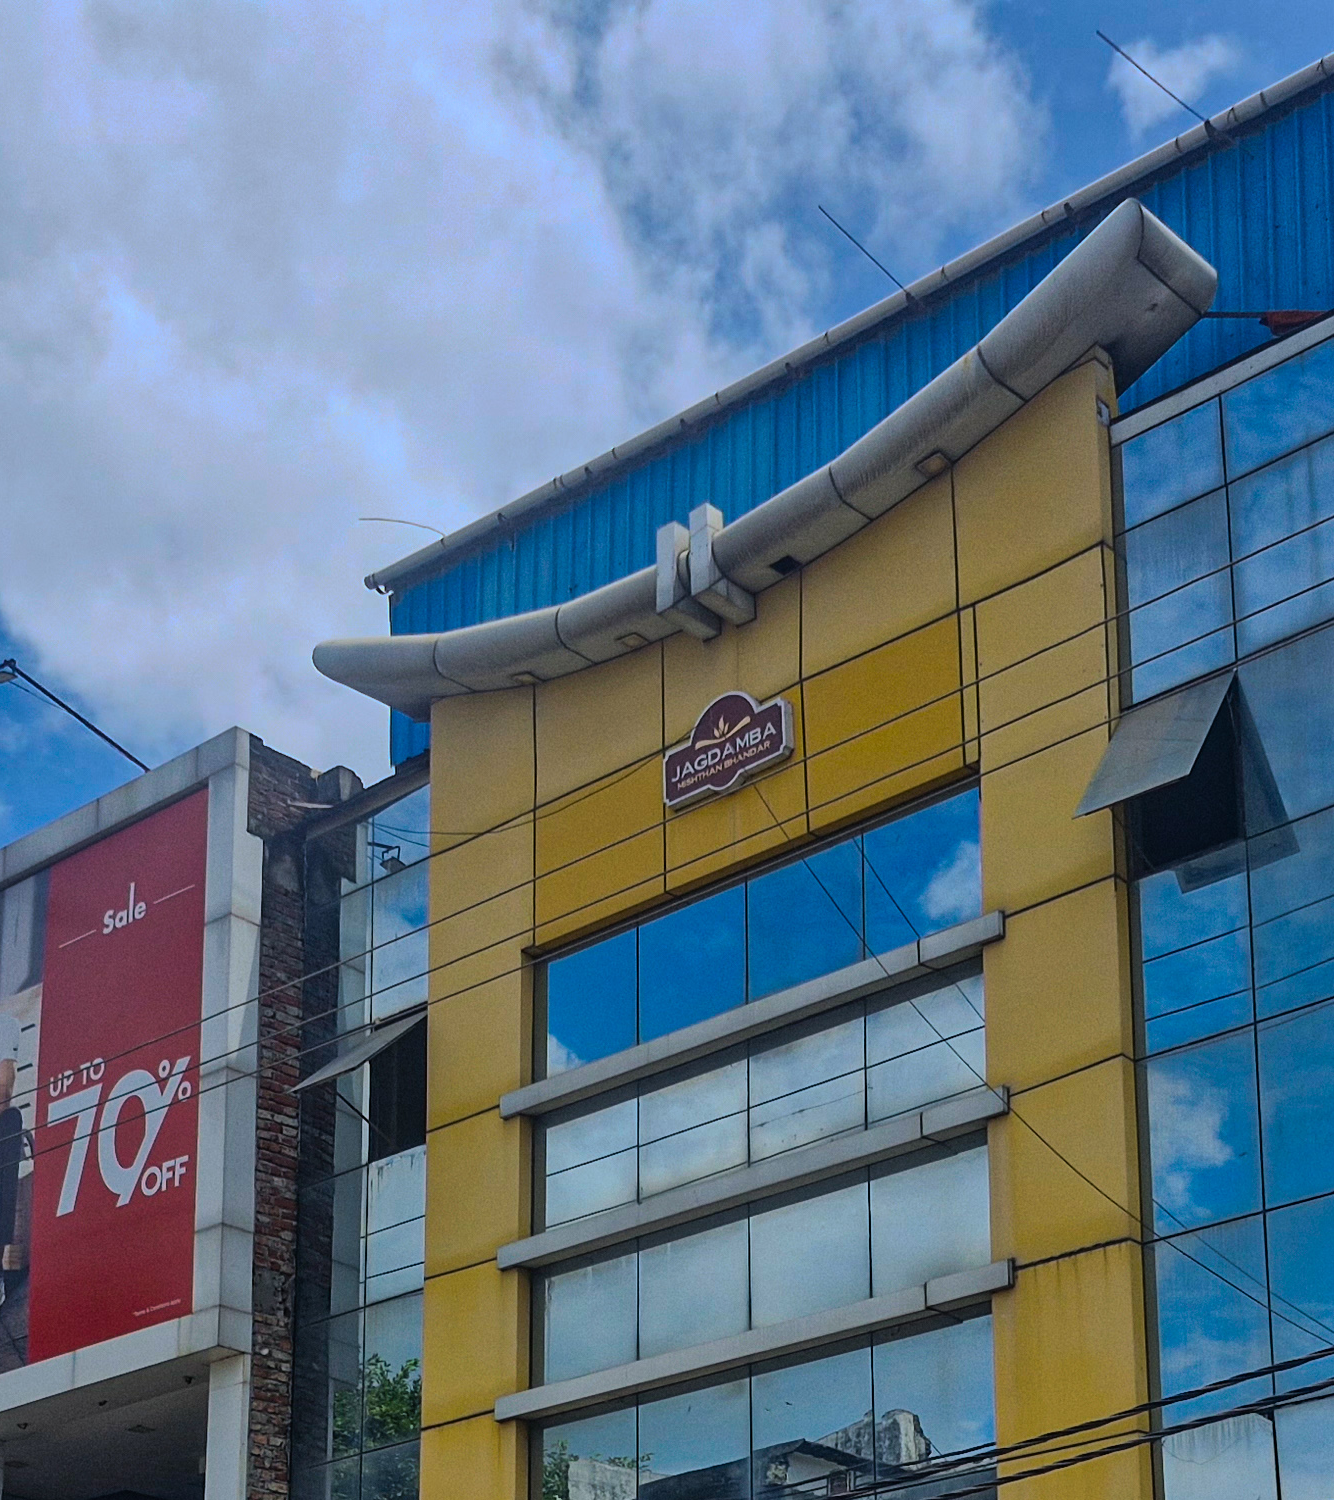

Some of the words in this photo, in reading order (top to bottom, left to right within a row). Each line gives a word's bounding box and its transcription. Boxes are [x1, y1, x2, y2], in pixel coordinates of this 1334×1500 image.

[671, 721, 777, 783] JAGDAMBA
[677, 763, 723, 791] MISHTHAN
[723, 740, 771, 769] BHANDAR
[102, 881, 147, 935] Sale
[49, 1069, 75, 1097] UP
[79, 1057, 106, 1085] TO
[46, 1055, 192, 1217] 70%
[140, 1154, 190, 1197] OFF
